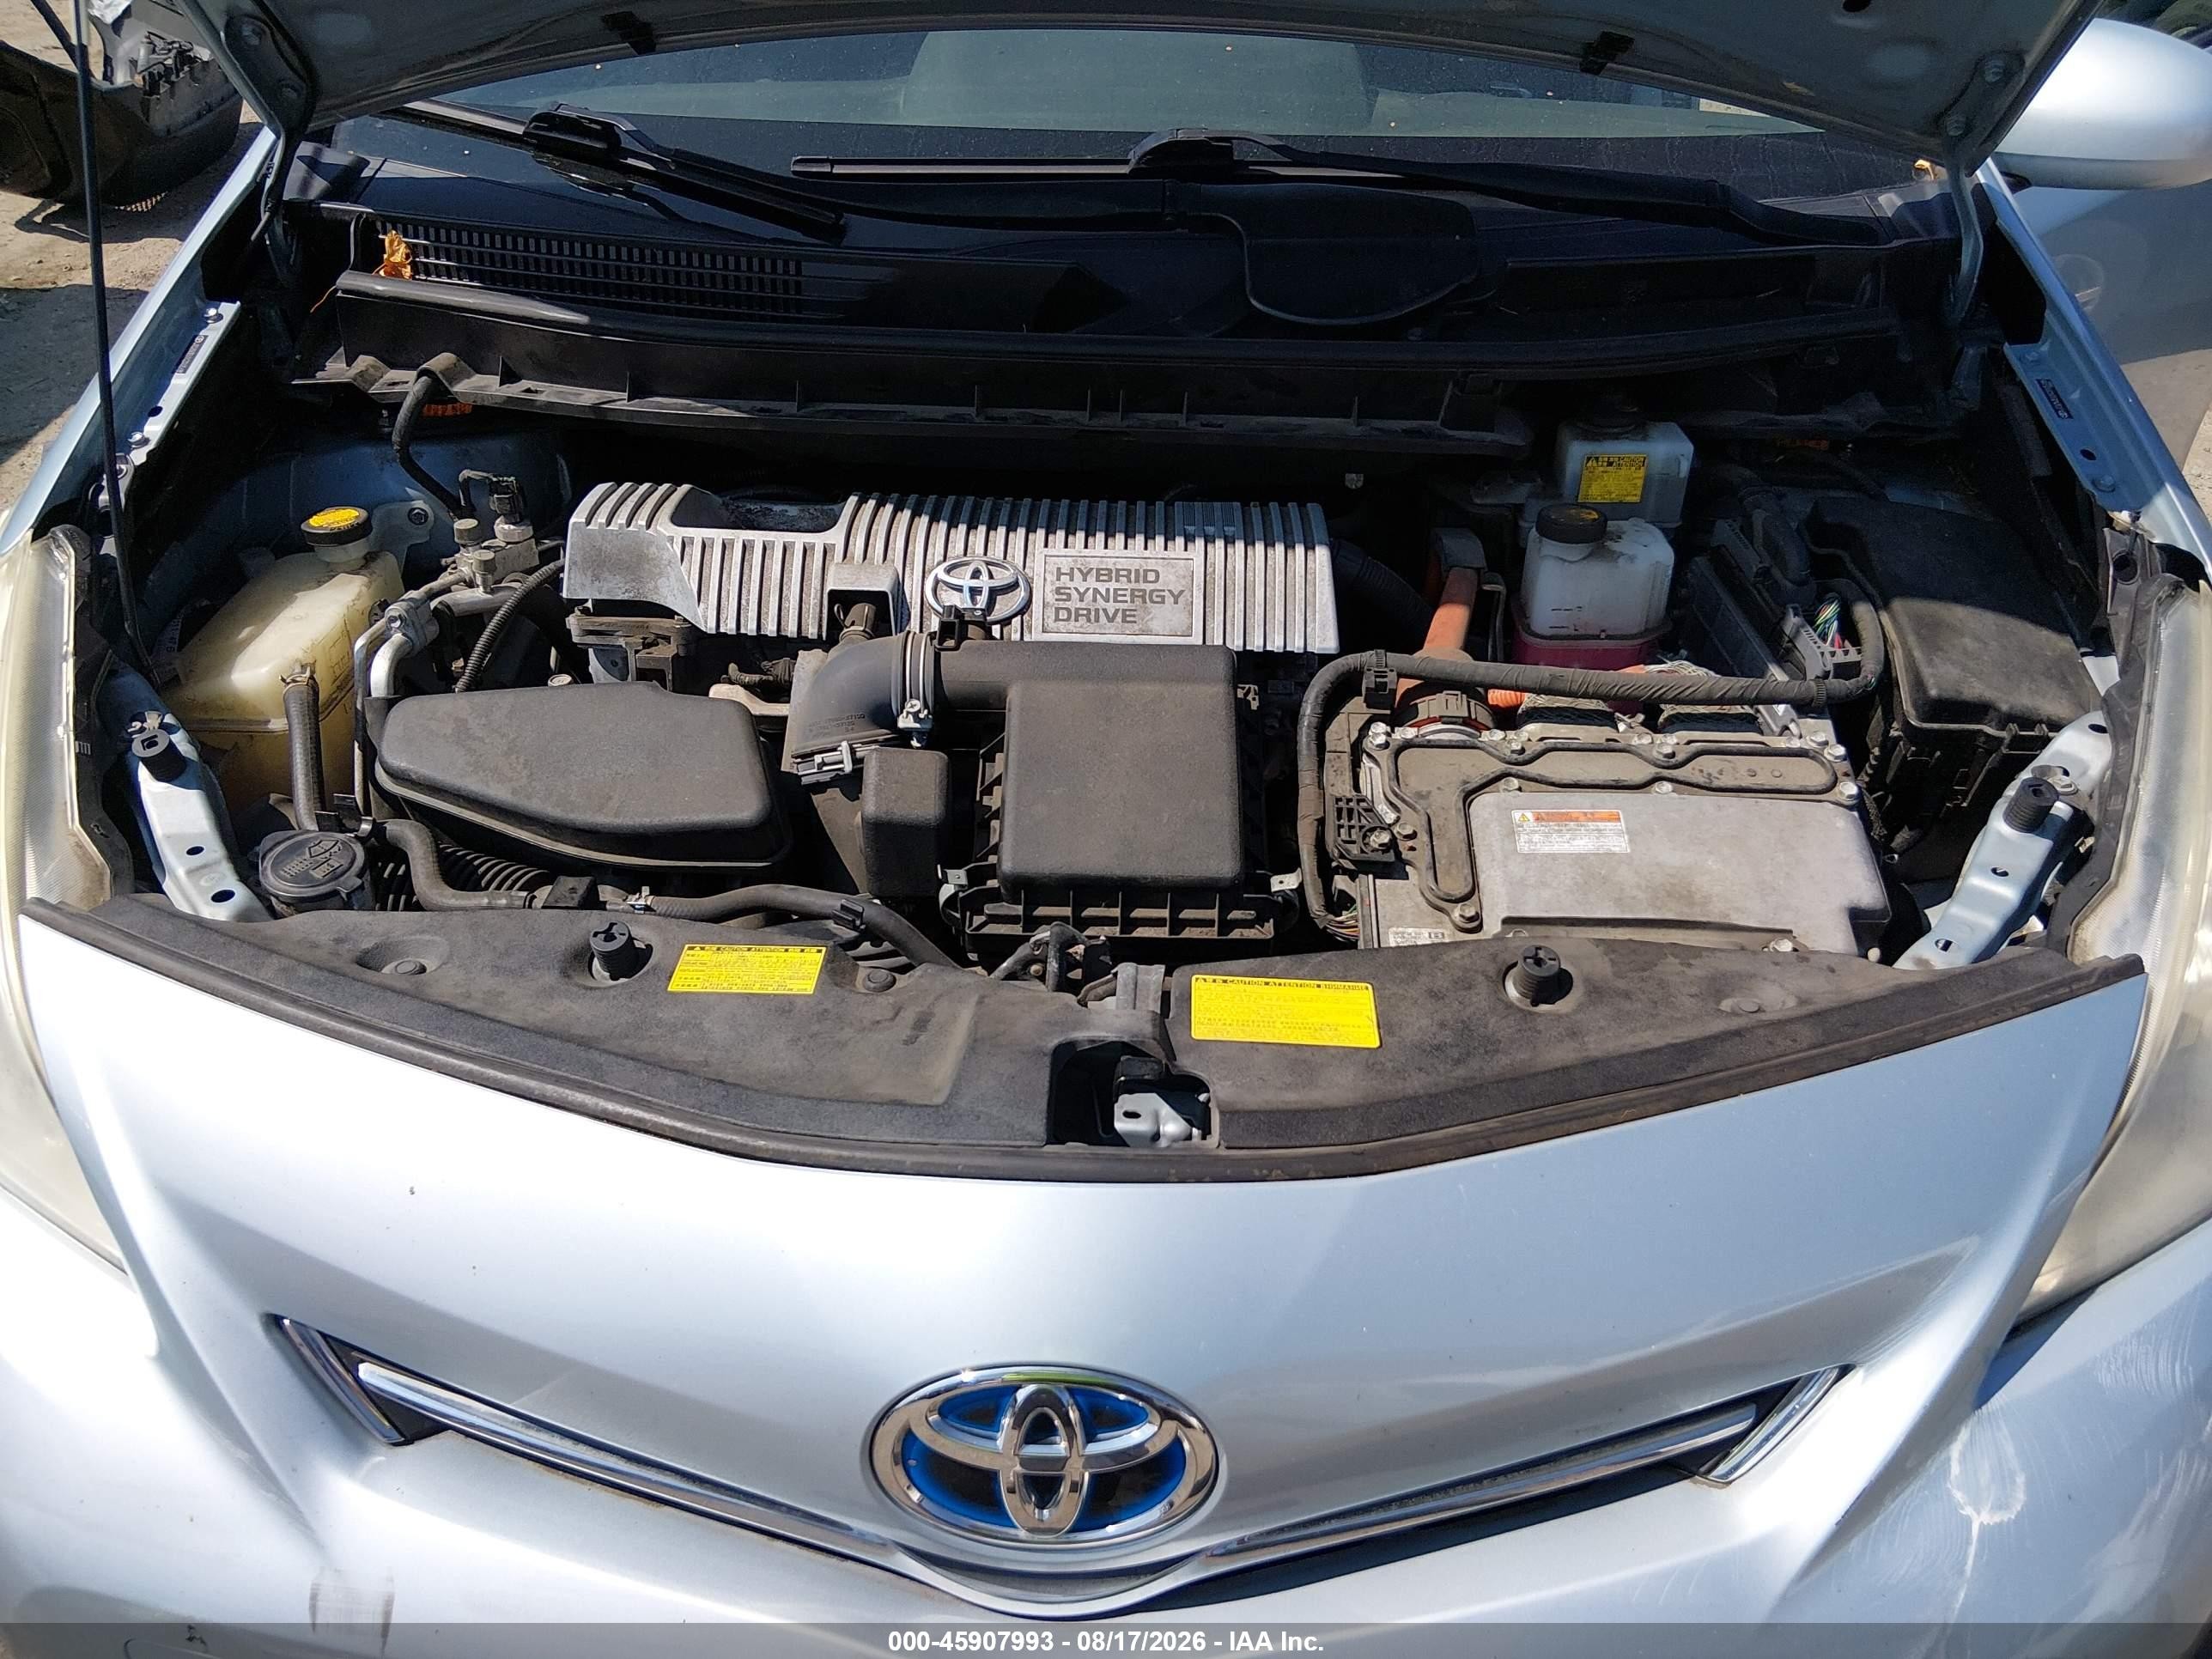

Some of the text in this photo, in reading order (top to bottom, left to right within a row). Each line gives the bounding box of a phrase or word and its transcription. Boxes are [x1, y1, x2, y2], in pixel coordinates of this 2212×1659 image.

[1056, 567, 1160, 584] HYBRID
[1054, 586, 1186, 605] SYNERGY
[1054, 606, 1138, 624] DRIVE
